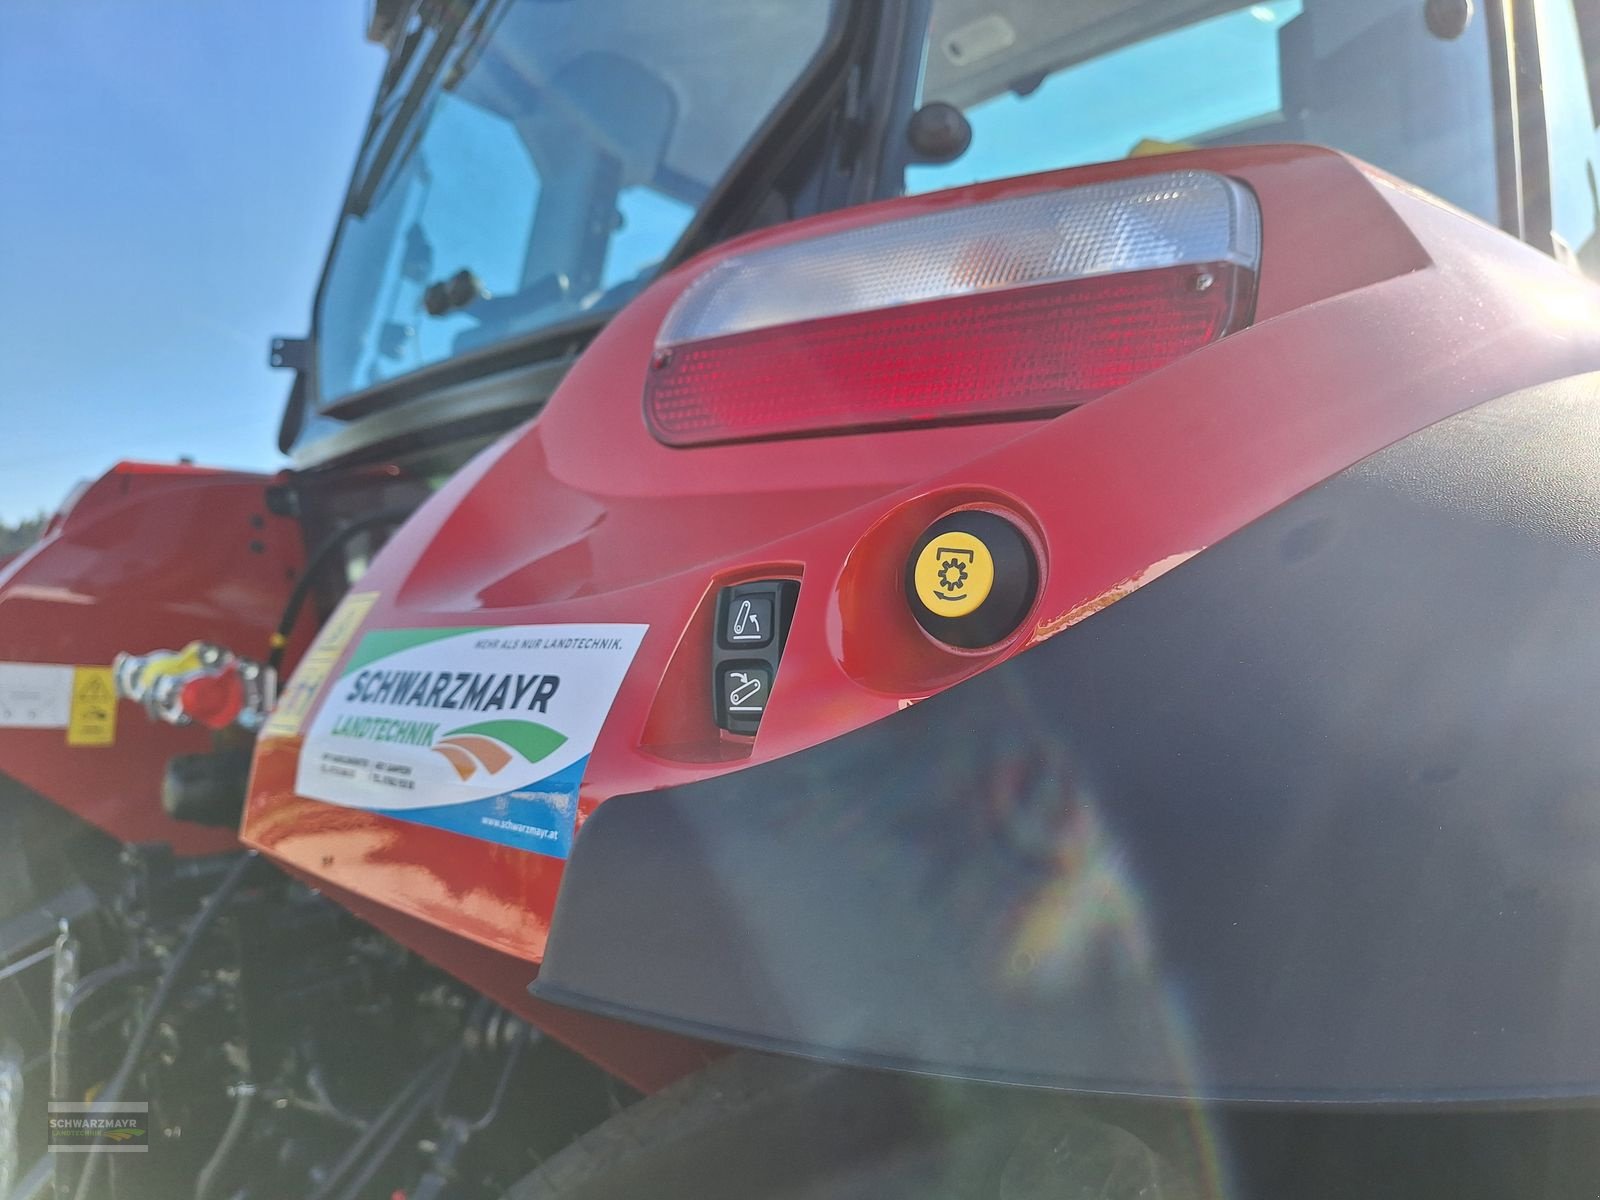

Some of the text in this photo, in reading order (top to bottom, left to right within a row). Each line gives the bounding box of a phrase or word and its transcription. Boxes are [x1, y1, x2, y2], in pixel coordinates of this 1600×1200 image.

[500, 639, 518, 649] ALS
[521, 639, 542, 649] NUR
[543, 638, 622, 650] LANDTECHNIK.
[346, 670, 560, 713] SCHWARZMAYR
[331, 715, 440, 746] LANDTECHNIK
[481, 816, 558, 840] www.schwarzmayr.at
